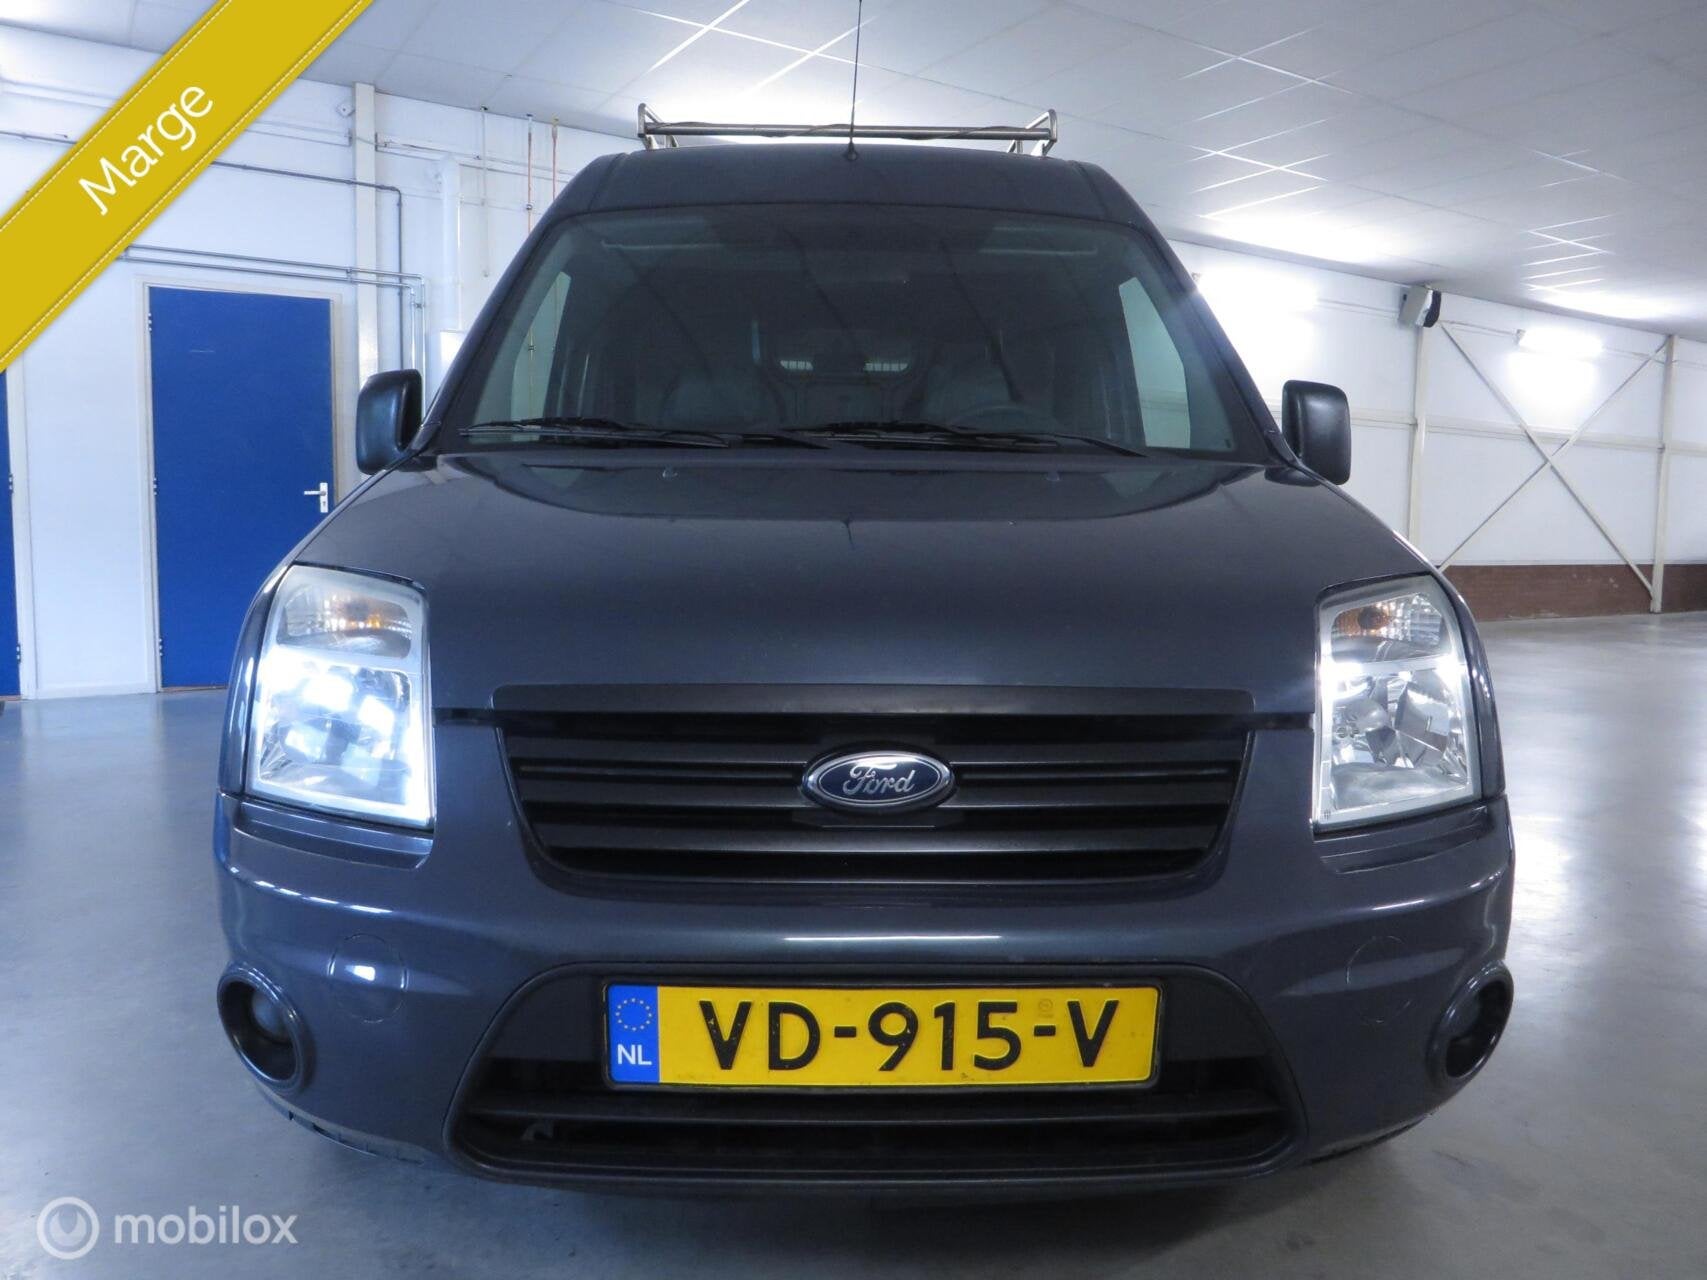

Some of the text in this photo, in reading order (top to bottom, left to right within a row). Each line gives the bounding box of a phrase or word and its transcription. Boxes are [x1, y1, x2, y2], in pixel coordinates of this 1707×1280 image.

[842, 763, 915, 795] Ford
[699, 1000, 1119, 1071] VD-915-V
[617, 1044, 652, 1065] NL
